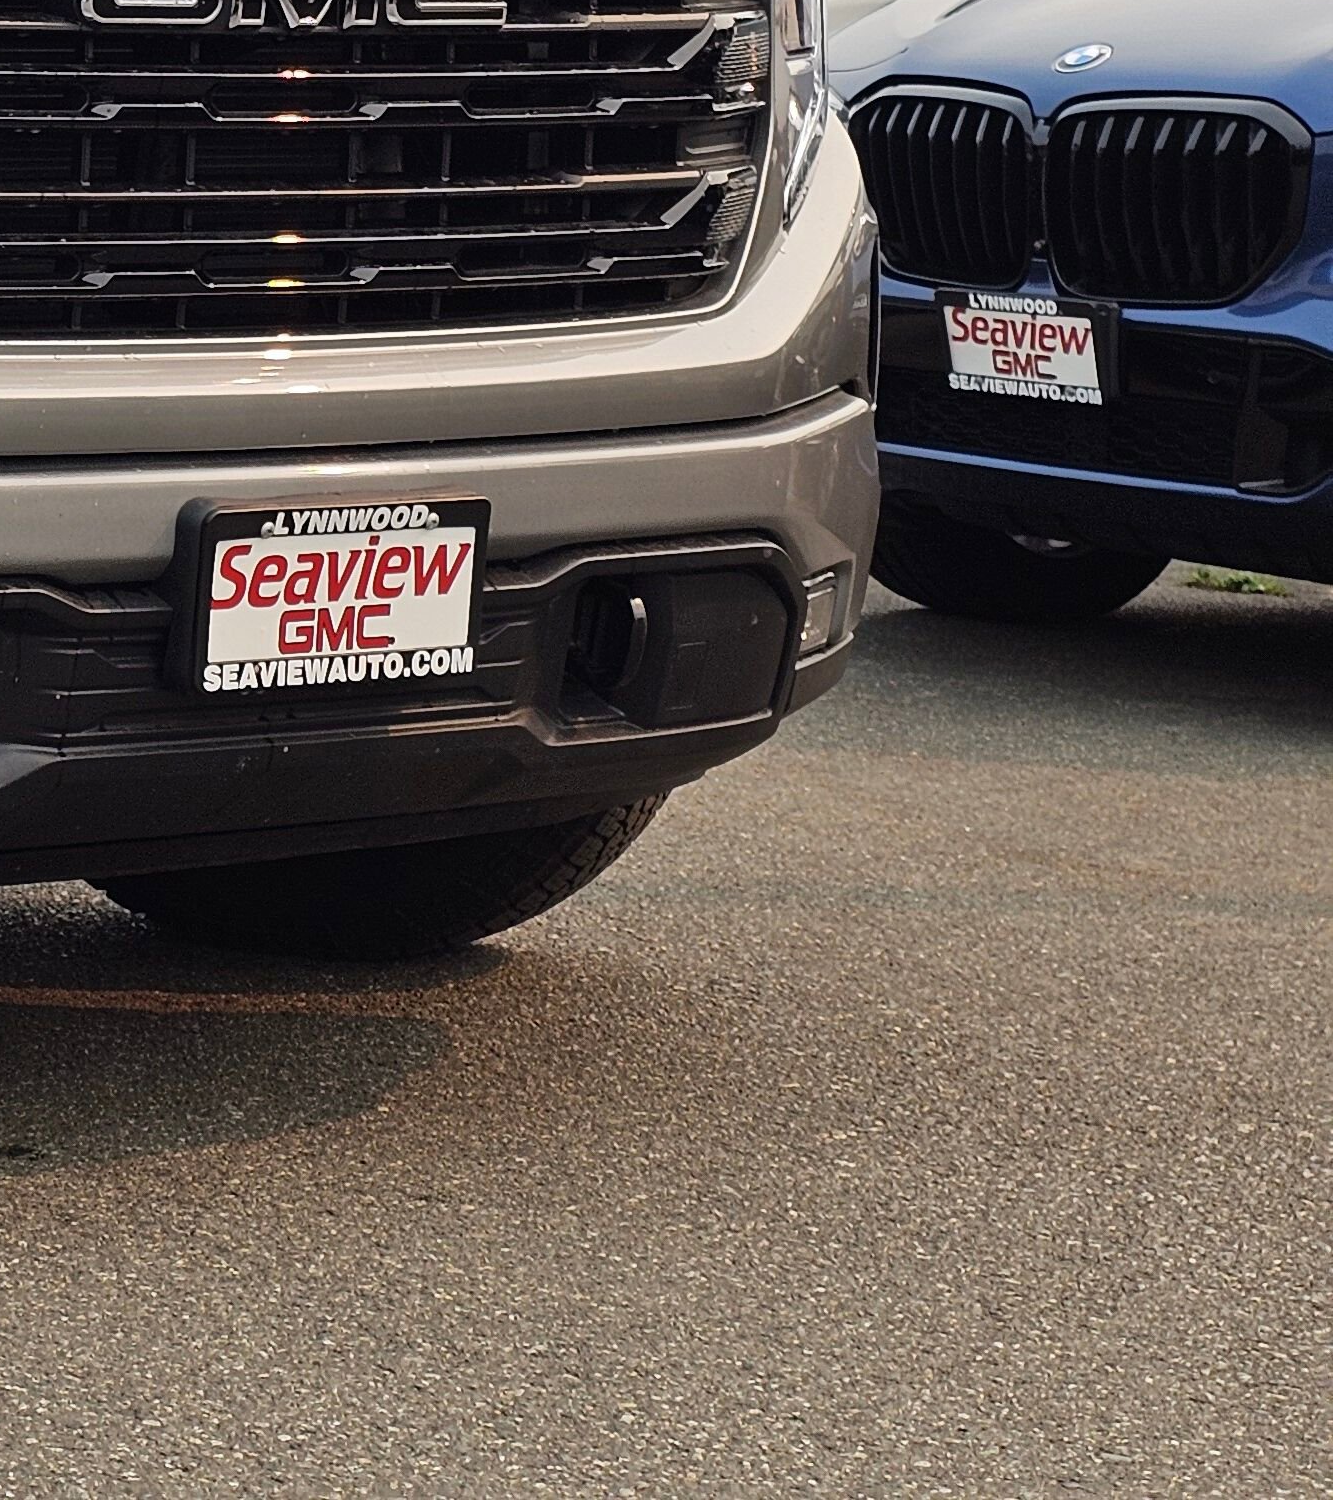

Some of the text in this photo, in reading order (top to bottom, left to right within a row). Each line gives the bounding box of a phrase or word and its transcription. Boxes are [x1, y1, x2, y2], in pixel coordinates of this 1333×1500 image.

[968, 293, 1058, 315] LYNNWOOD
[951, 307, 1091, 356] Seaview
[991, 349, 1057, 380] GMC
[948, 373, 1103, 406] SEAVIEWAUTO.COM
[273, 505, 429, 536] LYNNWOOD
[210, 535, 472, 610] Seaview
[279, 604, 395, 655] GMC
[202, 647, 474, 693] SEAVIEWAUTO.COM
